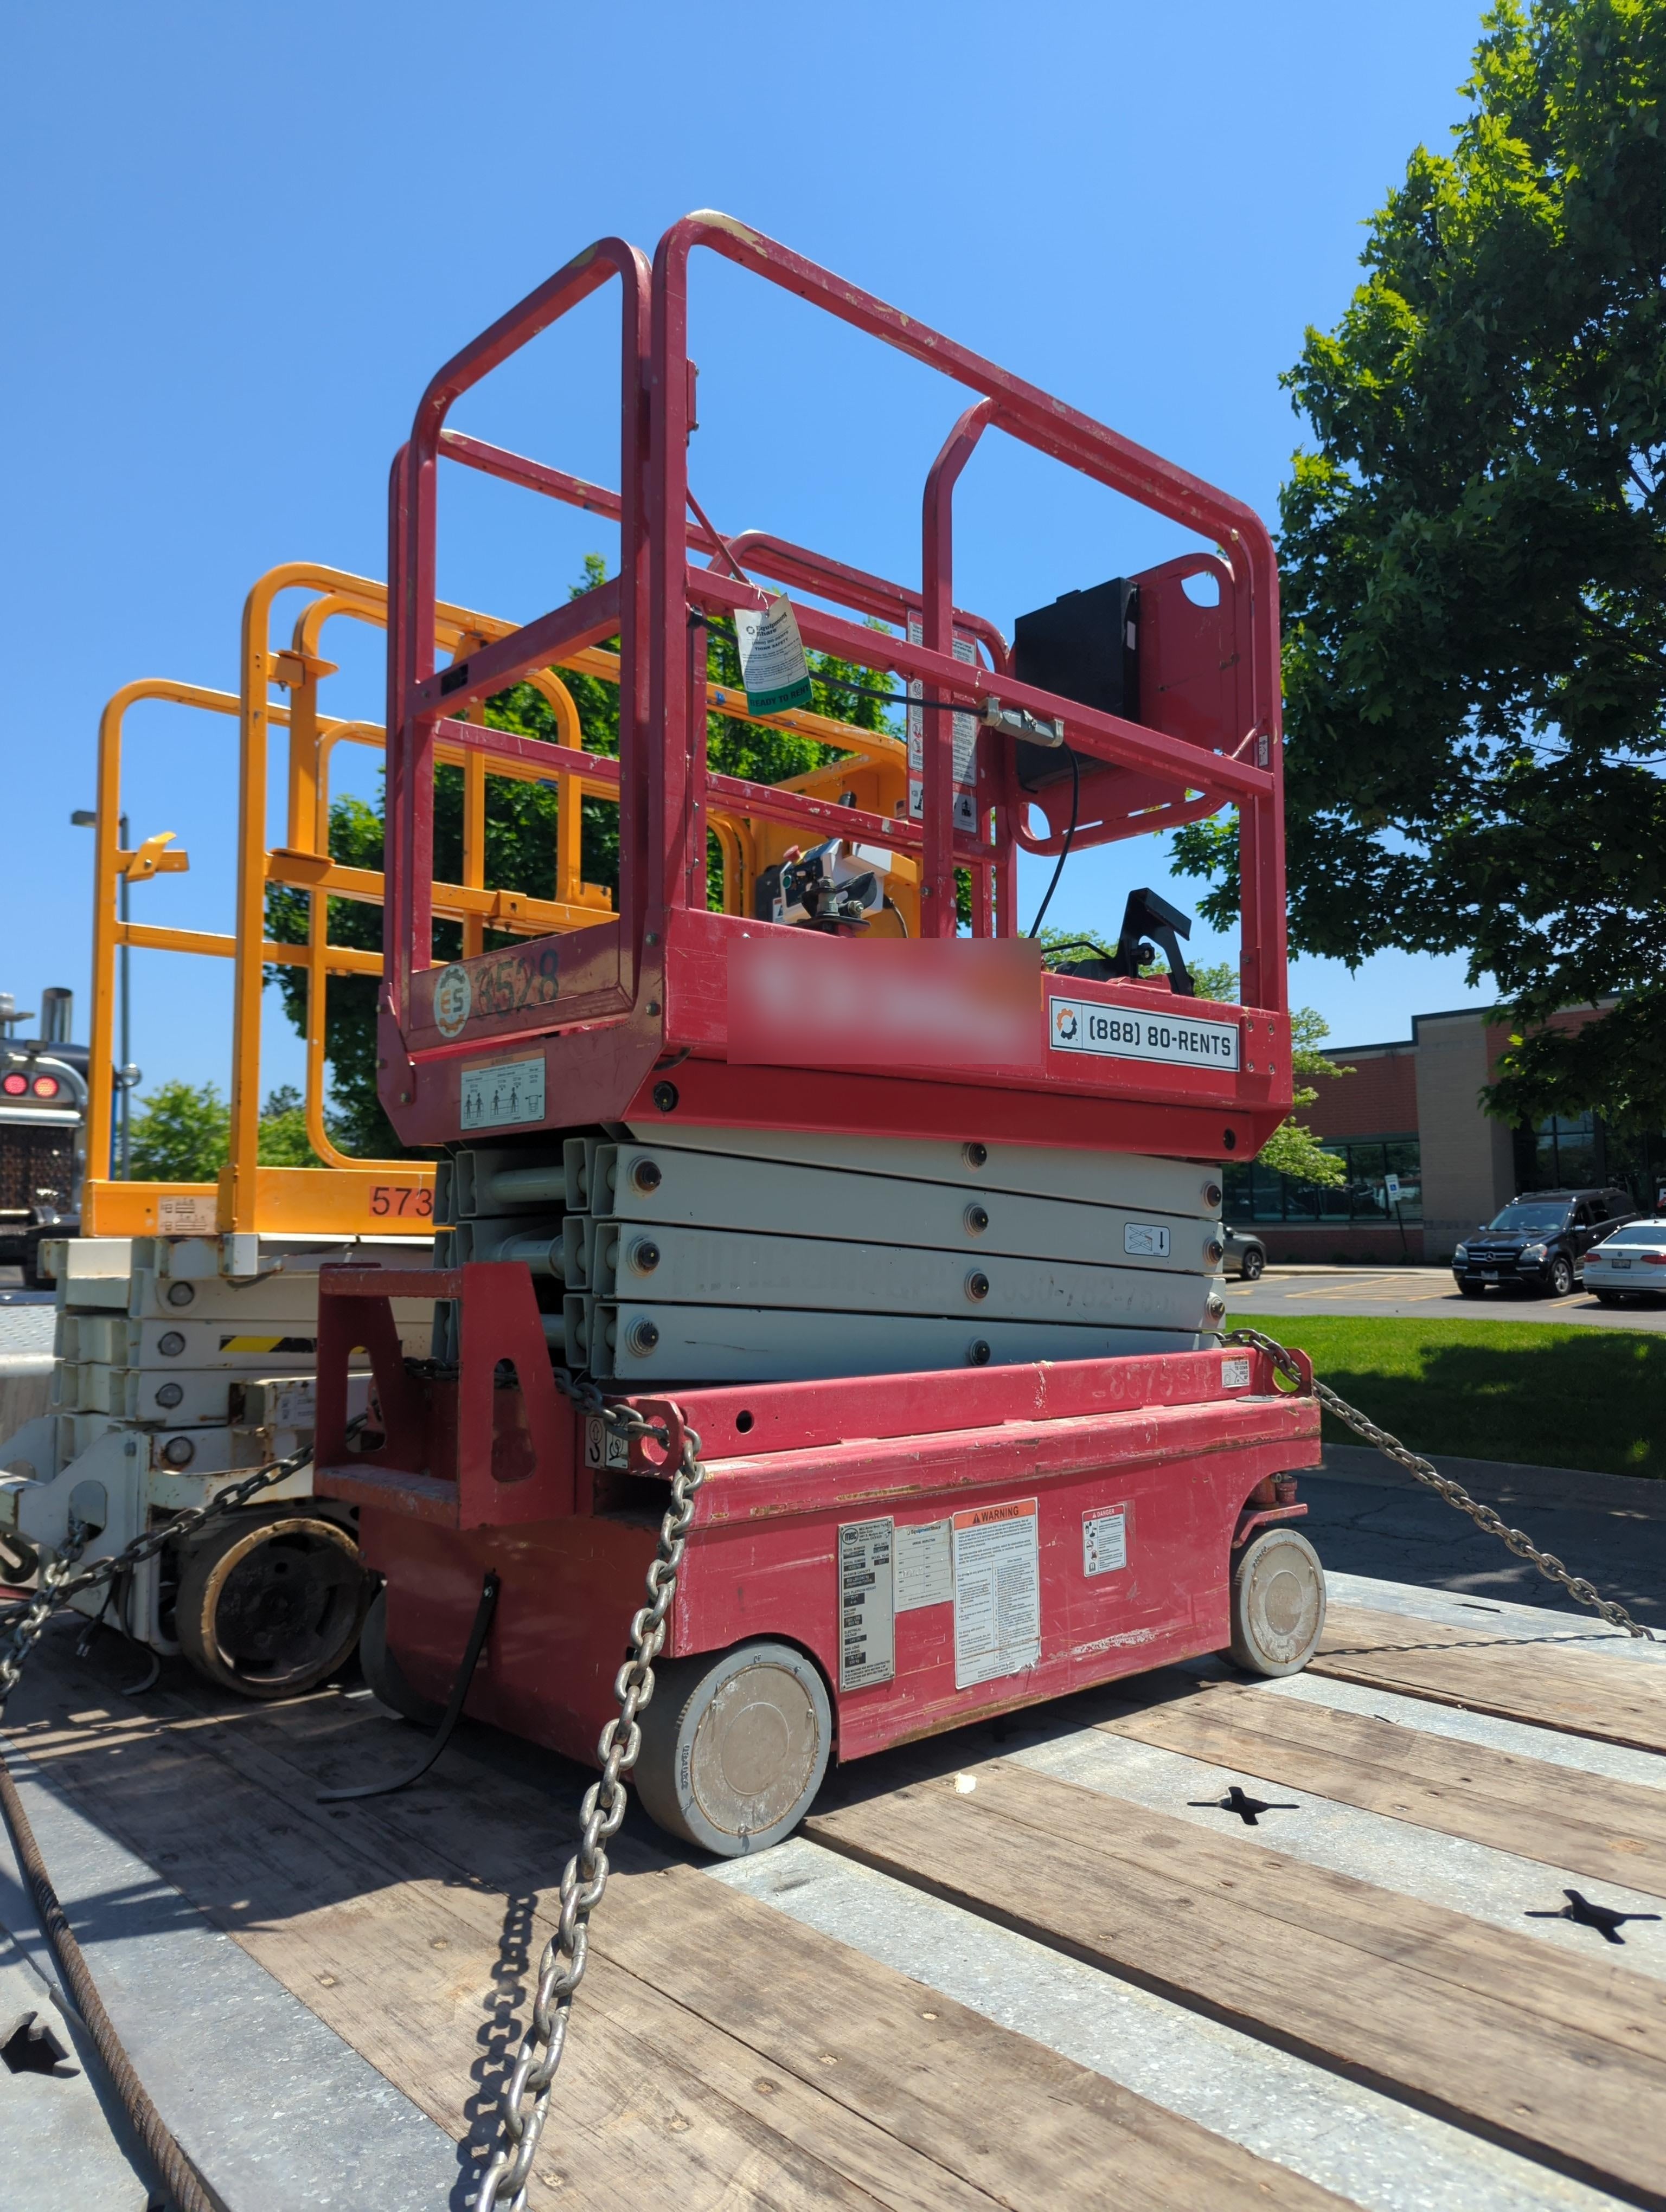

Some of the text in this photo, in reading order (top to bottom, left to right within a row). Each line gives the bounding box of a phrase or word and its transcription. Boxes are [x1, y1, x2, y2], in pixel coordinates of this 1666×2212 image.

[772, 637, 788, 648] SAFETY
[749, 684, 809, 707] READY TO RENT
[475, 949, 558, 1019] 3528
[440, 987, 464, 1015] ES
[1090, 1015, 1231, 1057] (888) 80-RENTS
[372, 1187, 433, 1217] 573
[982, 1506, 1018, 1522] WARNING
[1097, 1508, 1114, 1517] DANGER
[845, 1531, 856, 1541] mec
